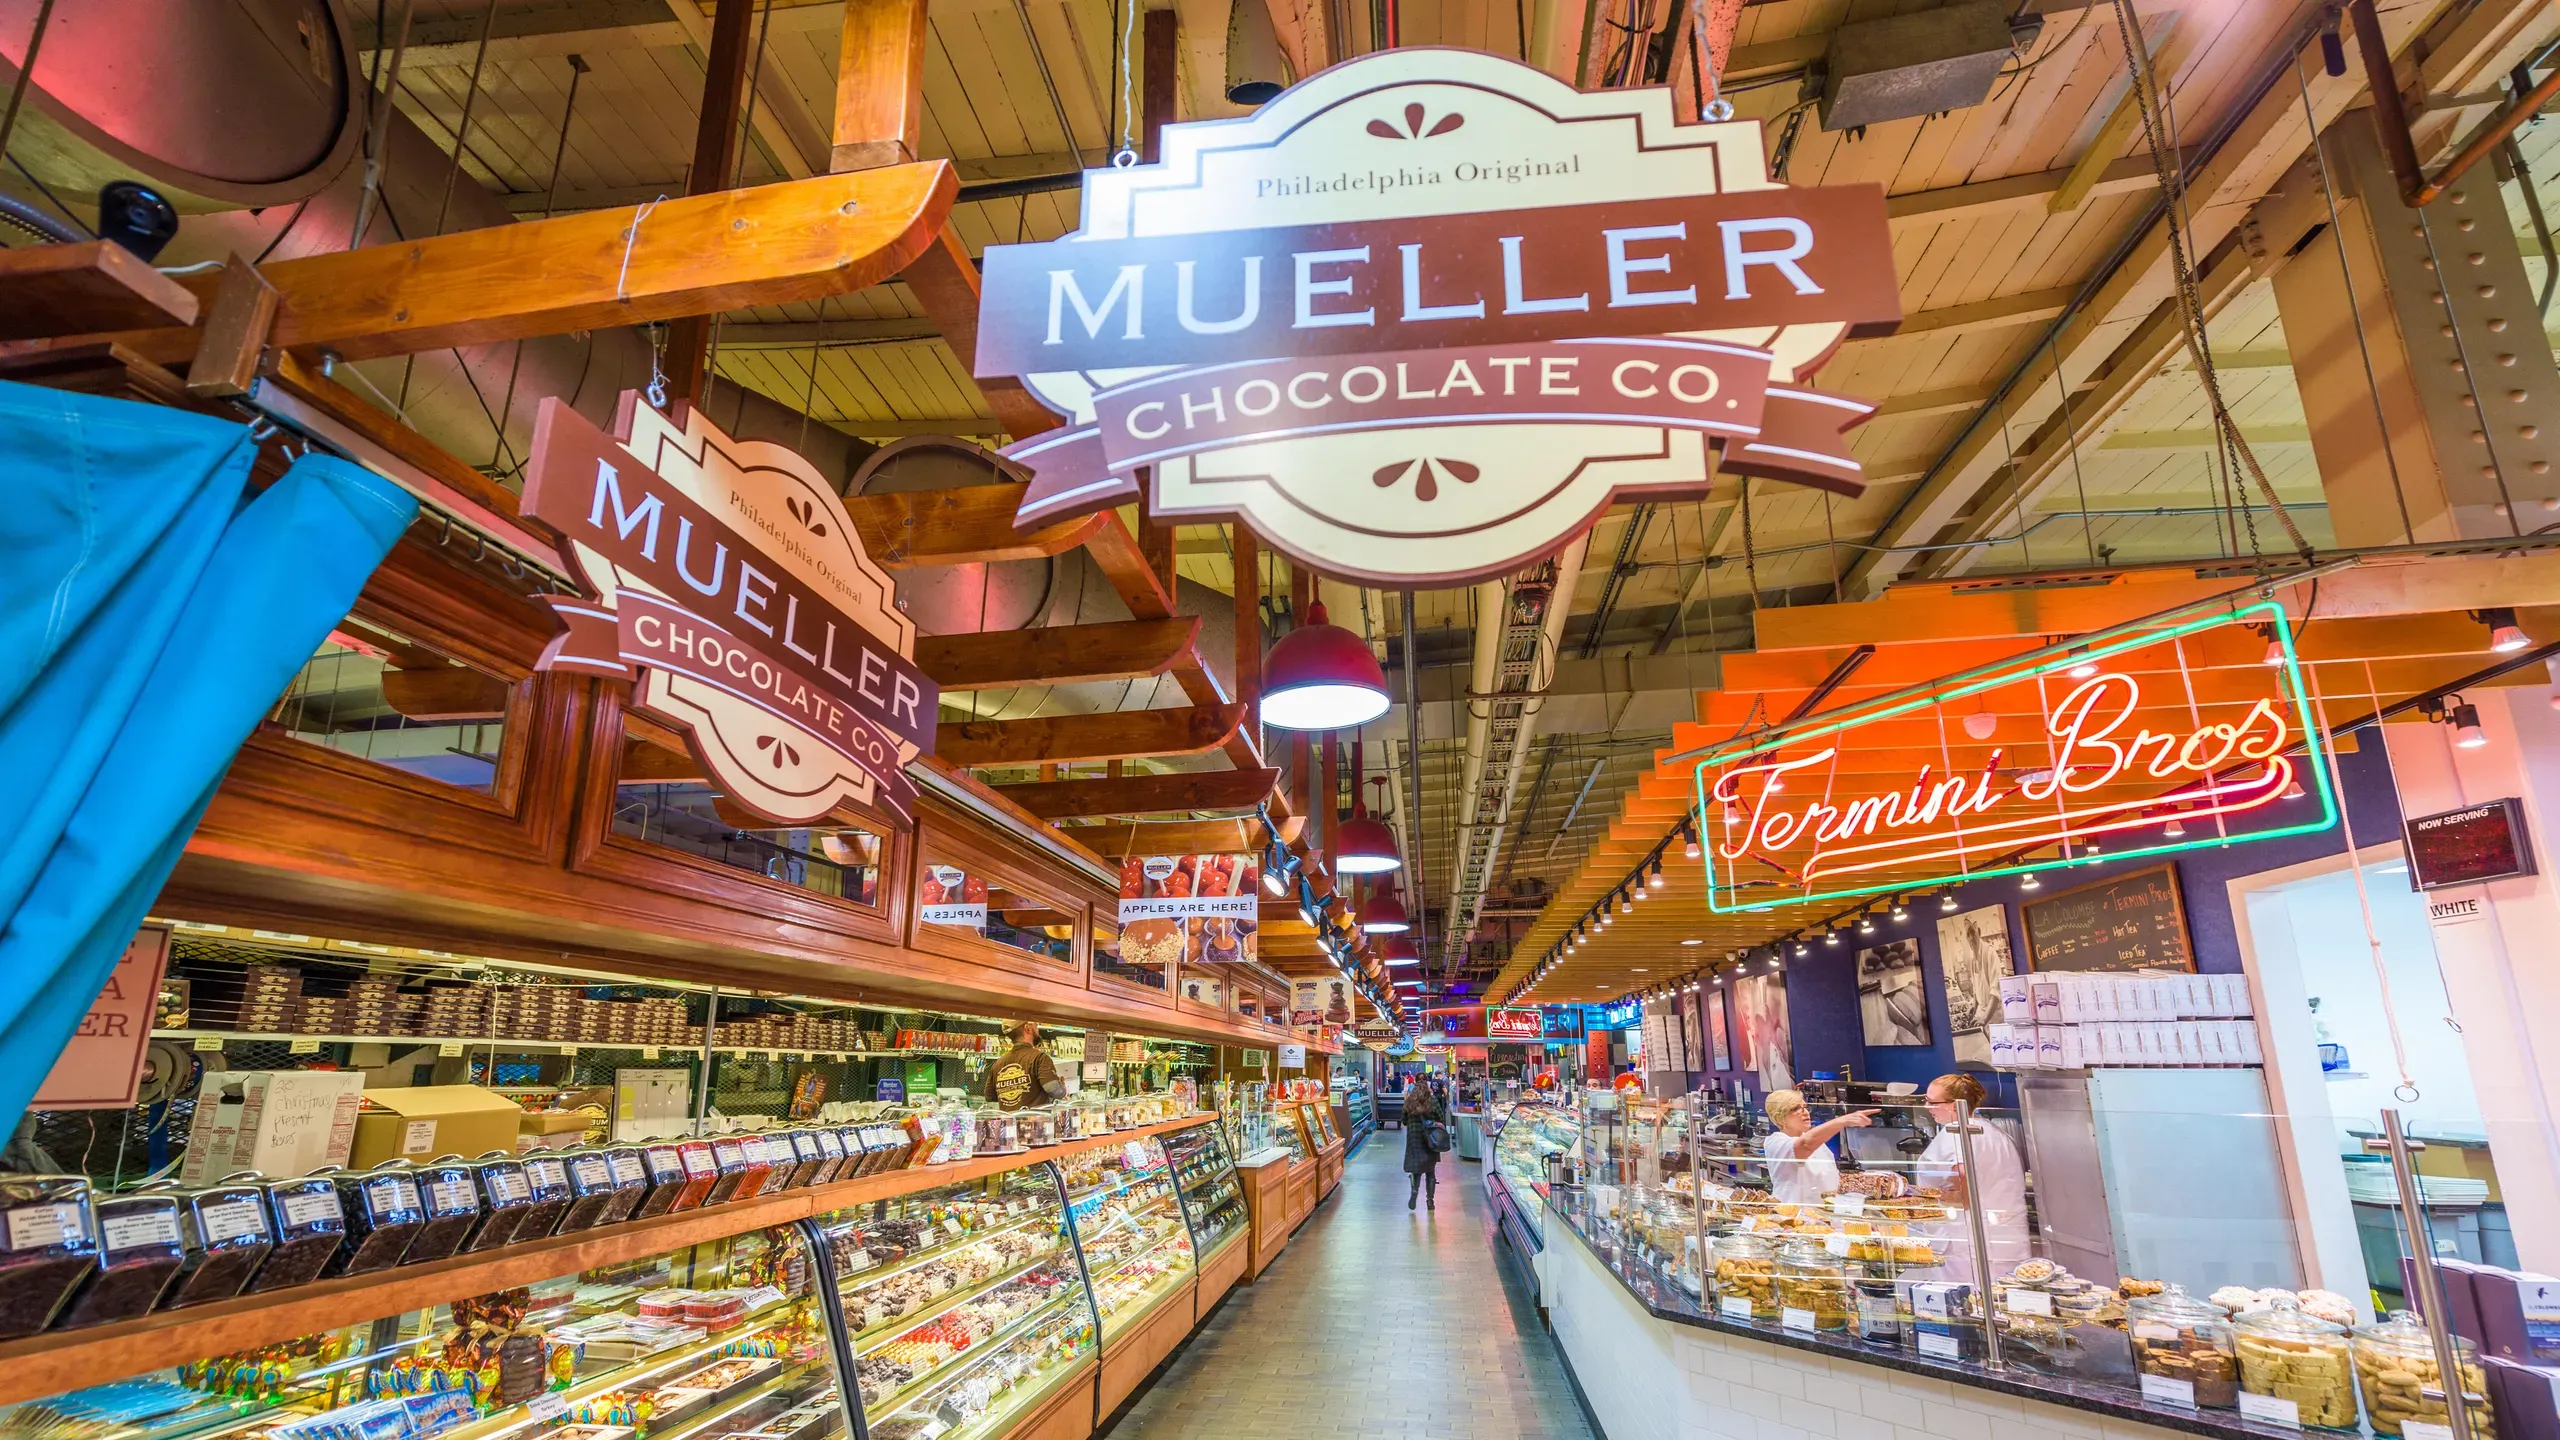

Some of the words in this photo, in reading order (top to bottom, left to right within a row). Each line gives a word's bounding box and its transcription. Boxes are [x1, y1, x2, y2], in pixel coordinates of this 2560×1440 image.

[1256, 166, 1442, 199] Philadelphia
[1454, 153, 1582, 187] Original
[1043, 216, 1825, 346] MUELLER
[1124, 355, 1582, 440] CHOCOLATE
[1612, 357, 1740, 410] CO.
[729, 489, 813, 568] Philadelphia
[816, 559, 863, 606] Original
[586, 456, 921, 731] MUELLER
[633, 614, 845, 737] CHOCOLATE
[851, 725, 889, 775] CO.
[1712, 747, 2004, 860] Termini
[2019, 672, 2288, 801] Bros
[2418, 818, 2442, 831] NOW
[2443, 808, 2489, 826] SERVING
[1123, 904, 1174, 914] APPLES
[1179, 903, 1206, 913] ARE
[1211, 901, 1253, 912] HERE!
[2107, 886, 2149, 912] TERMINI
[2430, 899, 2478, 917] WHITE
[2036, 943, 2060, 961] COFFEE
[2118, 949, 2134, 961] ICED
[274, 1079, 295, 1095] 20
